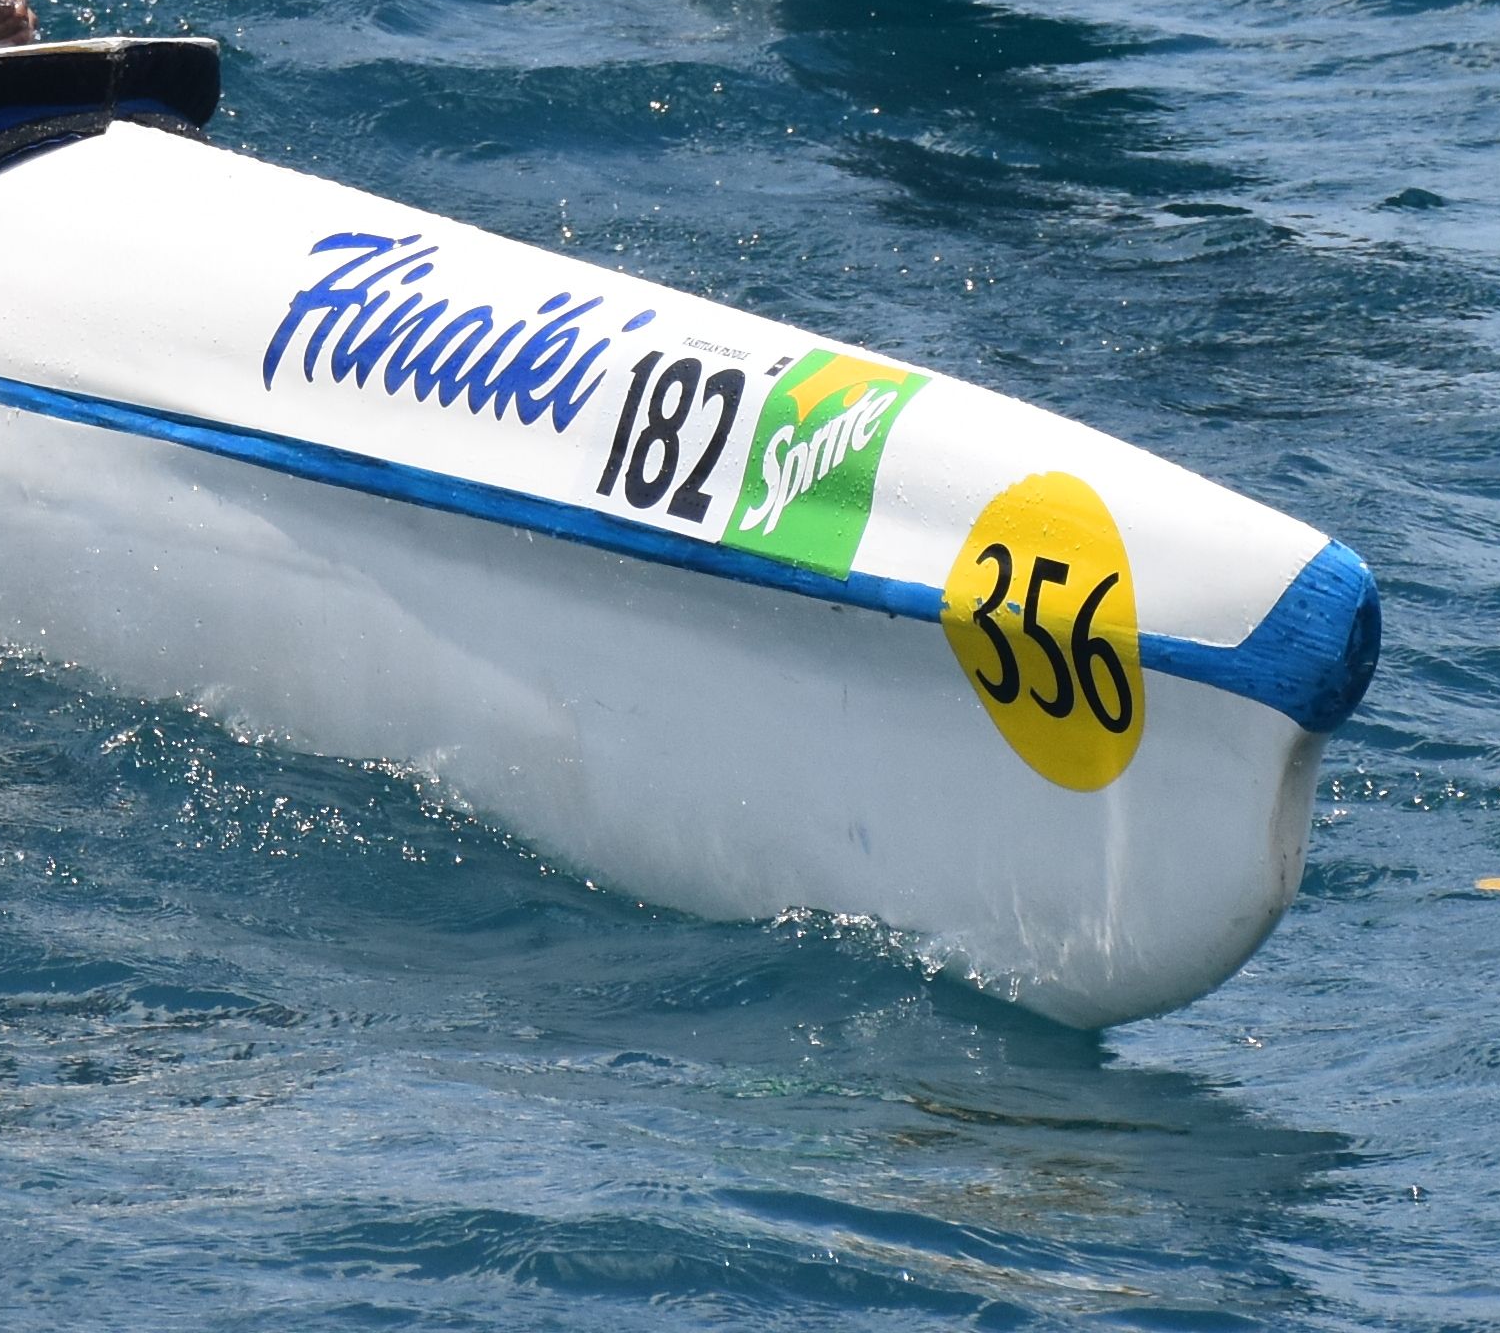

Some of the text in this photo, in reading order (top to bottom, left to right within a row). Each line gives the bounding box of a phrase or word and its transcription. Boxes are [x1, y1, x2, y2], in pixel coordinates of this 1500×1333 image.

[596, 350, 746, 525] 182
[739, 386, 899, 536] Sprite
[973, 543, 1133, 734] 356
